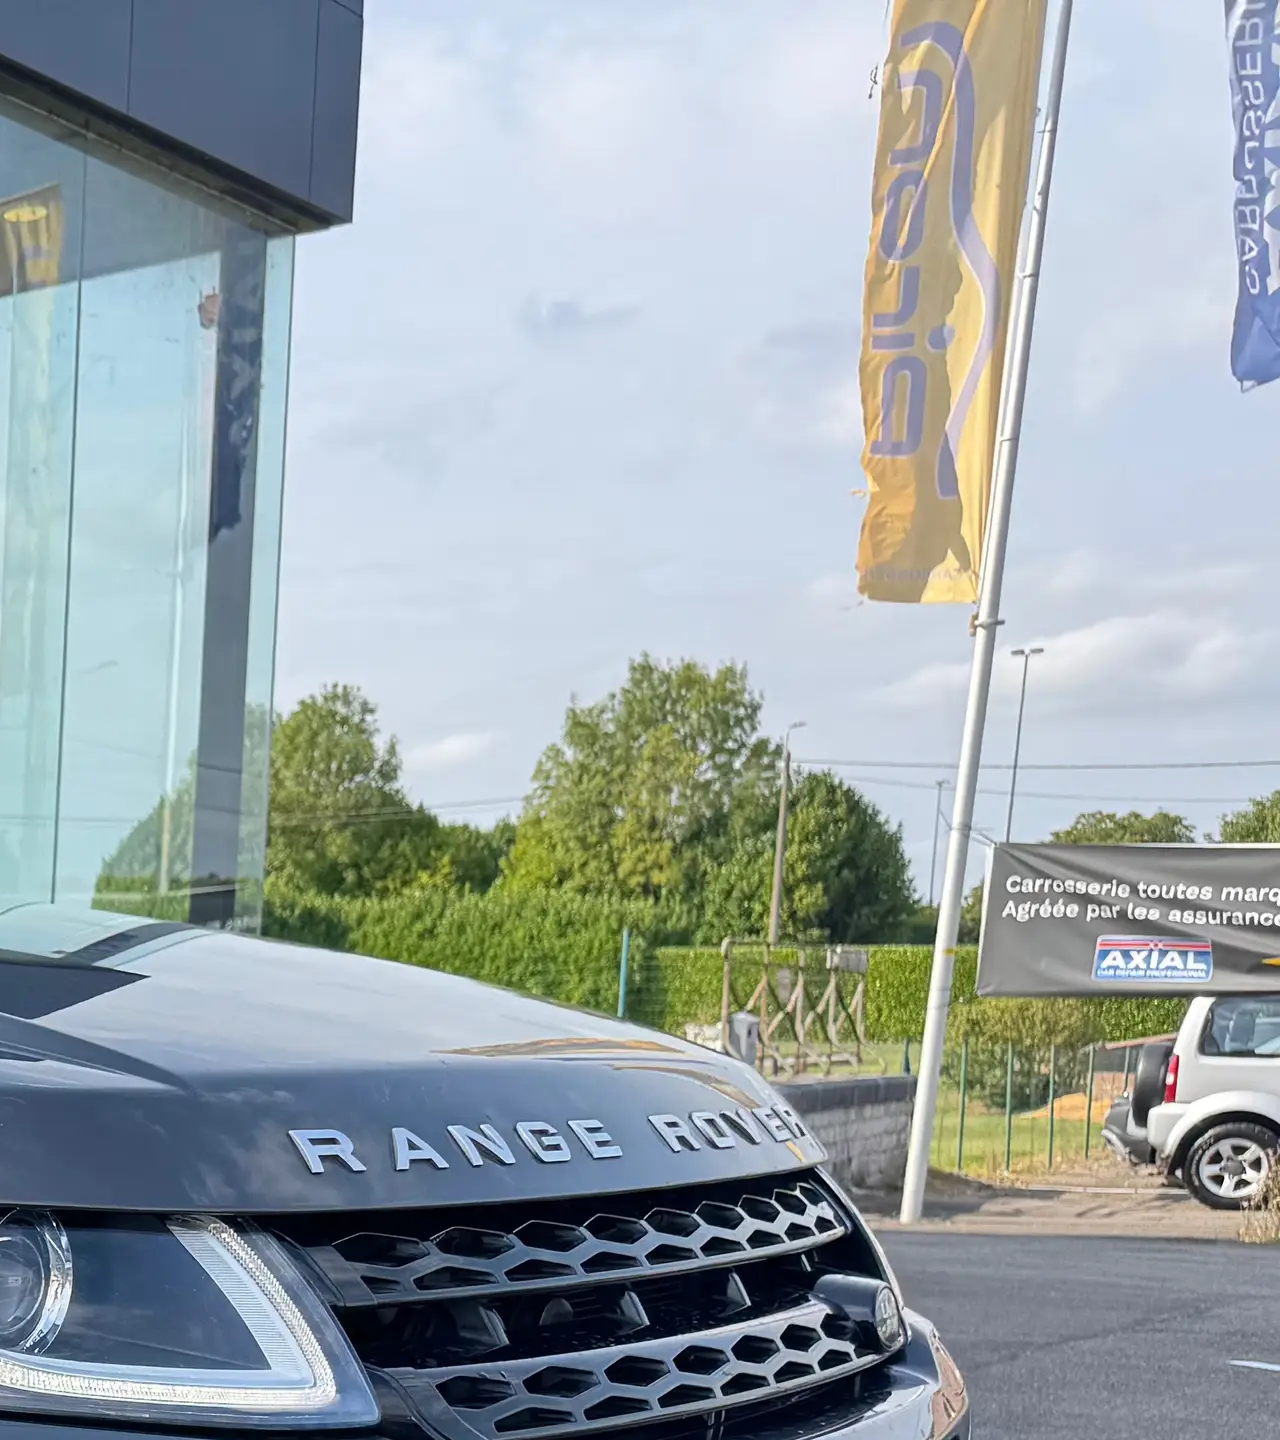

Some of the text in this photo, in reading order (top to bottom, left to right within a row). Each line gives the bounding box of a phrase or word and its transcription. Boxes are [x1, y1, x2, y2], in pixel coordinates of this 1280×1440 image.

[1005, 875, 1131, 898] Carrosserie
[1137, 881, 1213, 900] toutes
[1002, 898, 1079, 922] Agréée
[1086, 903, 1121, 922] par
[1127, 902, 1160, 920] les
[1100, 950, 1207, 970] AXIAL
[288, 1104, 808, 1174] RANGE ROVER
